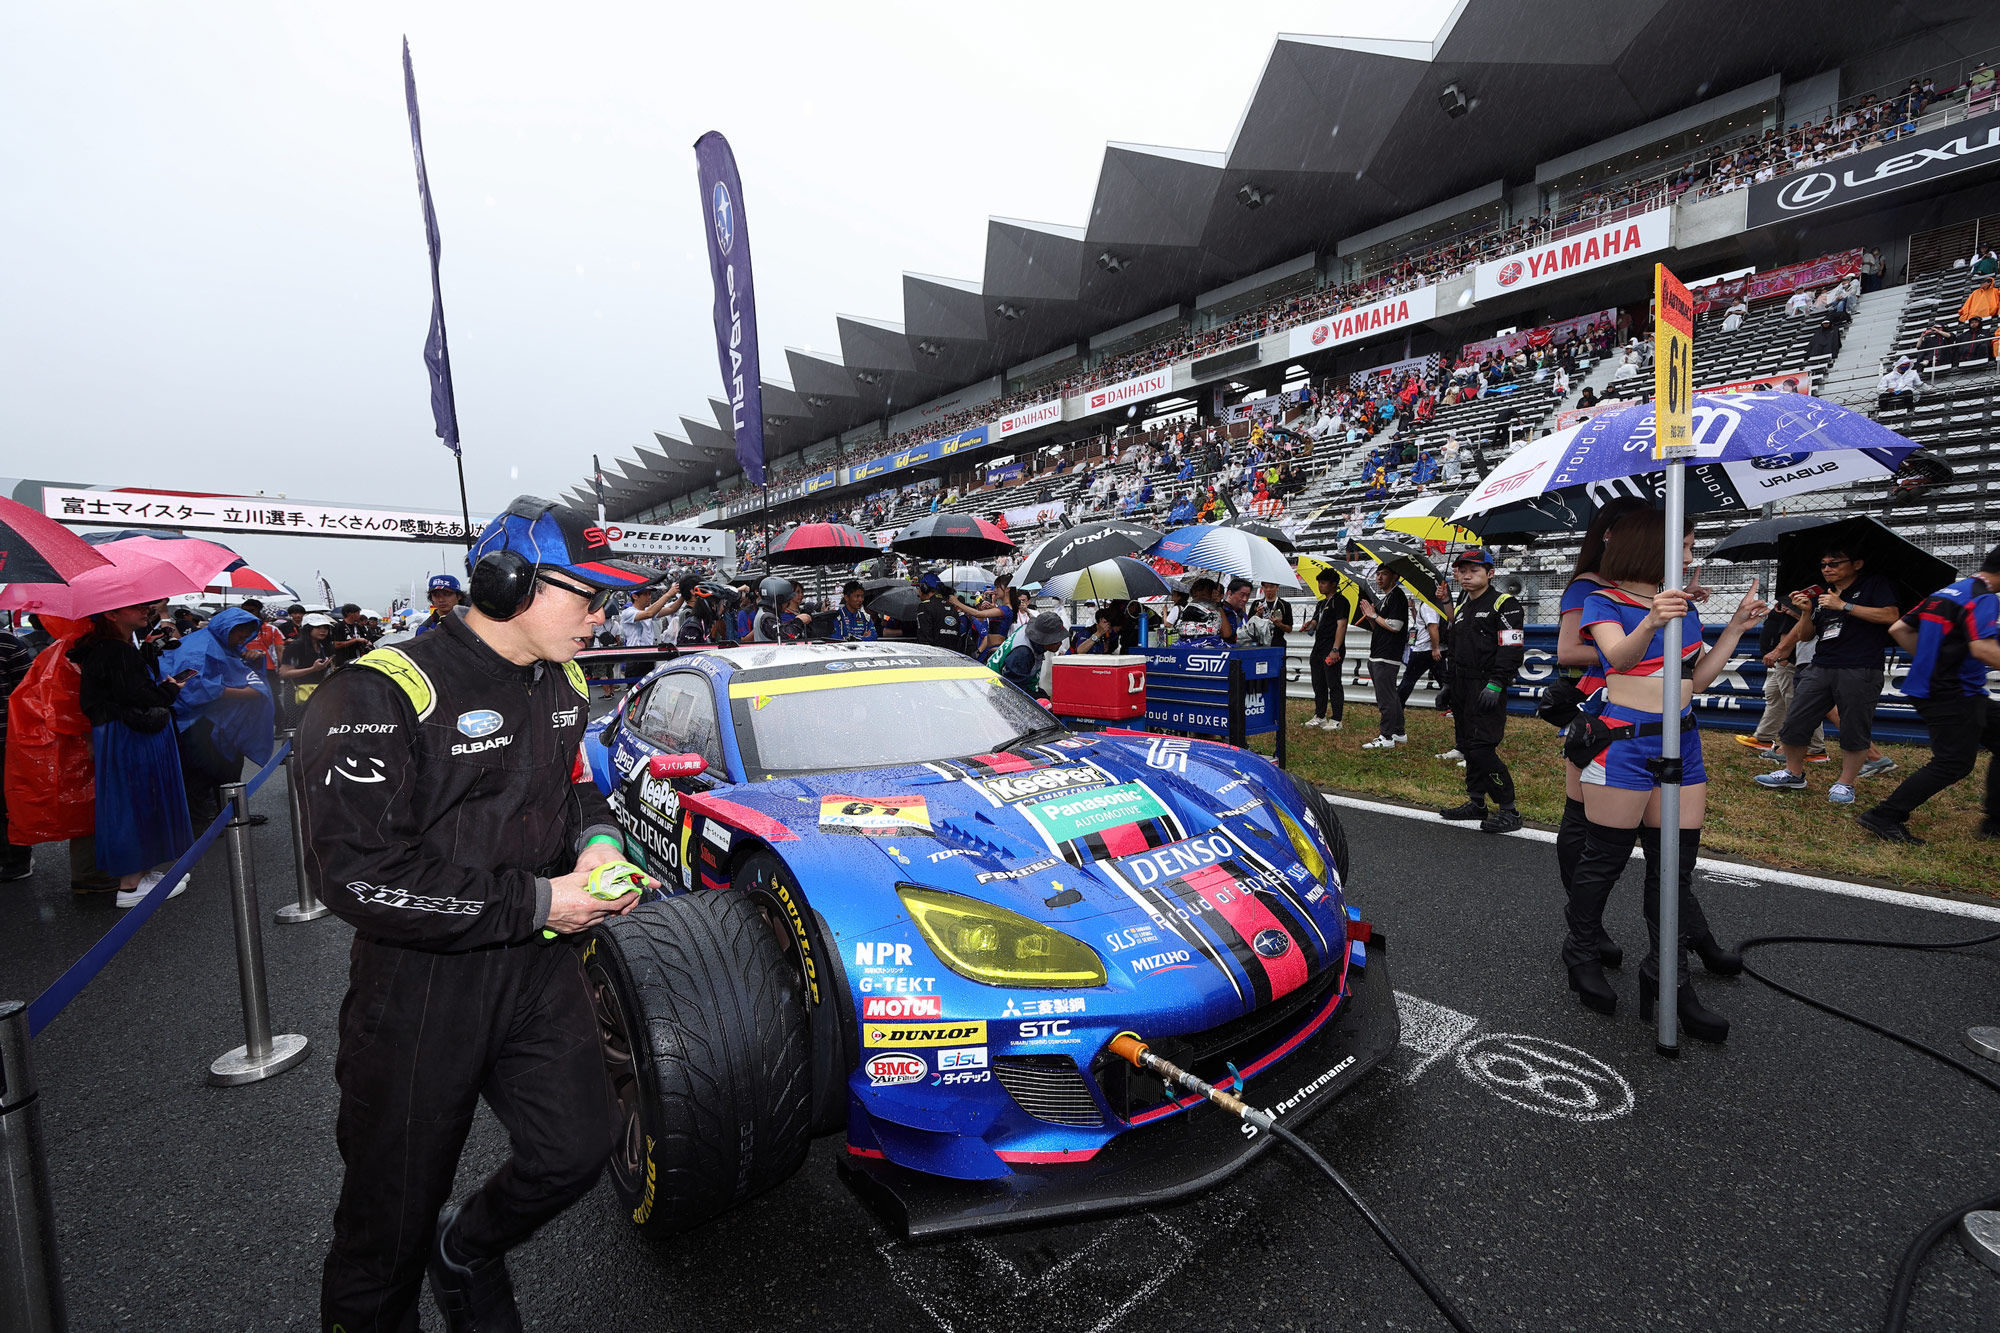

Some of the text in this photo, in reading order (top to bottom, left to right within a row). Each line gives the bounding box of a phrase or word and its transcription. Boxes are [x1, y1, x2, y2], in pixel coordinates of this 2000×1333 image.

[1528, 224, 1642, 279] YAMAHA
[1332, 299, 1410, 340] YAMAHA
[726, 263, 746, 432] SUBARU
[1394, 362, 1422, 372] TOYOTA
[1669, 335, 1687, 414] 61
[1107, 375, 1166, 404] DAIHATSU
[1014, 405, 1060, 429] DAIHATSU
[1556, 437, 1597, 483] Proud
[61, 497, 215, 520] 富士マイスター
[607, 528, 712, 544] SPEEDWAY
[624, 543, 712, 552] MOTORSPORTS
[1061, 527, 1143, 558] DUNLOP
[852, 658, 922, 668] SUBARU
[1155, 655, 1177, 663] Tools
[1186, 652, 1230, 673] STI
[552, 706, 579, 728] STI
[1145, 711, 1228, 728] roud of BOXER
[1245, 707, 1265, 715] OOLS
[353, 723, 398, 734] SPORT
[451, 735, 513, 756] SUBARU
[659, 760, 702, 771] スバル興産
[640, 770, 680, 819] KeePer
[987, 767, 1101, 800] KeePer
[1041, 789, 1142, 820] Panasonic
[1074, 805, 1141, 828] AUTOMOTIVE
[641, 819, 679, 868] DENSO
[1128, 835, 1233, 886] DENSO
[1152, 868, 1290, 930] Proud of BOXER
[777, 886, 819, 1004] DUNLOP
[1106, 929, 1136, 952] SLS
[856, 942, 913, 966] NPR
[1131, 950, 1190, 973] MIZUHO
[859, 977, 936, 992] G-TEKT
[866, 998, 937, 1017] MOTUL
[1022, 997, 1086, 1016] 三菱製鋼
[888, 1027, 979, 1041] DUNLOP
[1019, 1020, 1071, 1037] STC
[873, 1061, 919, 1075] BMC
[875, 1073, 916, 1083] Air Filter
[943, 1070, 991, 1085] ダイテック
[1241, 1055, 1357, 1139] SI Performance
[633, 1162, 656, 1224] DUNLOP
